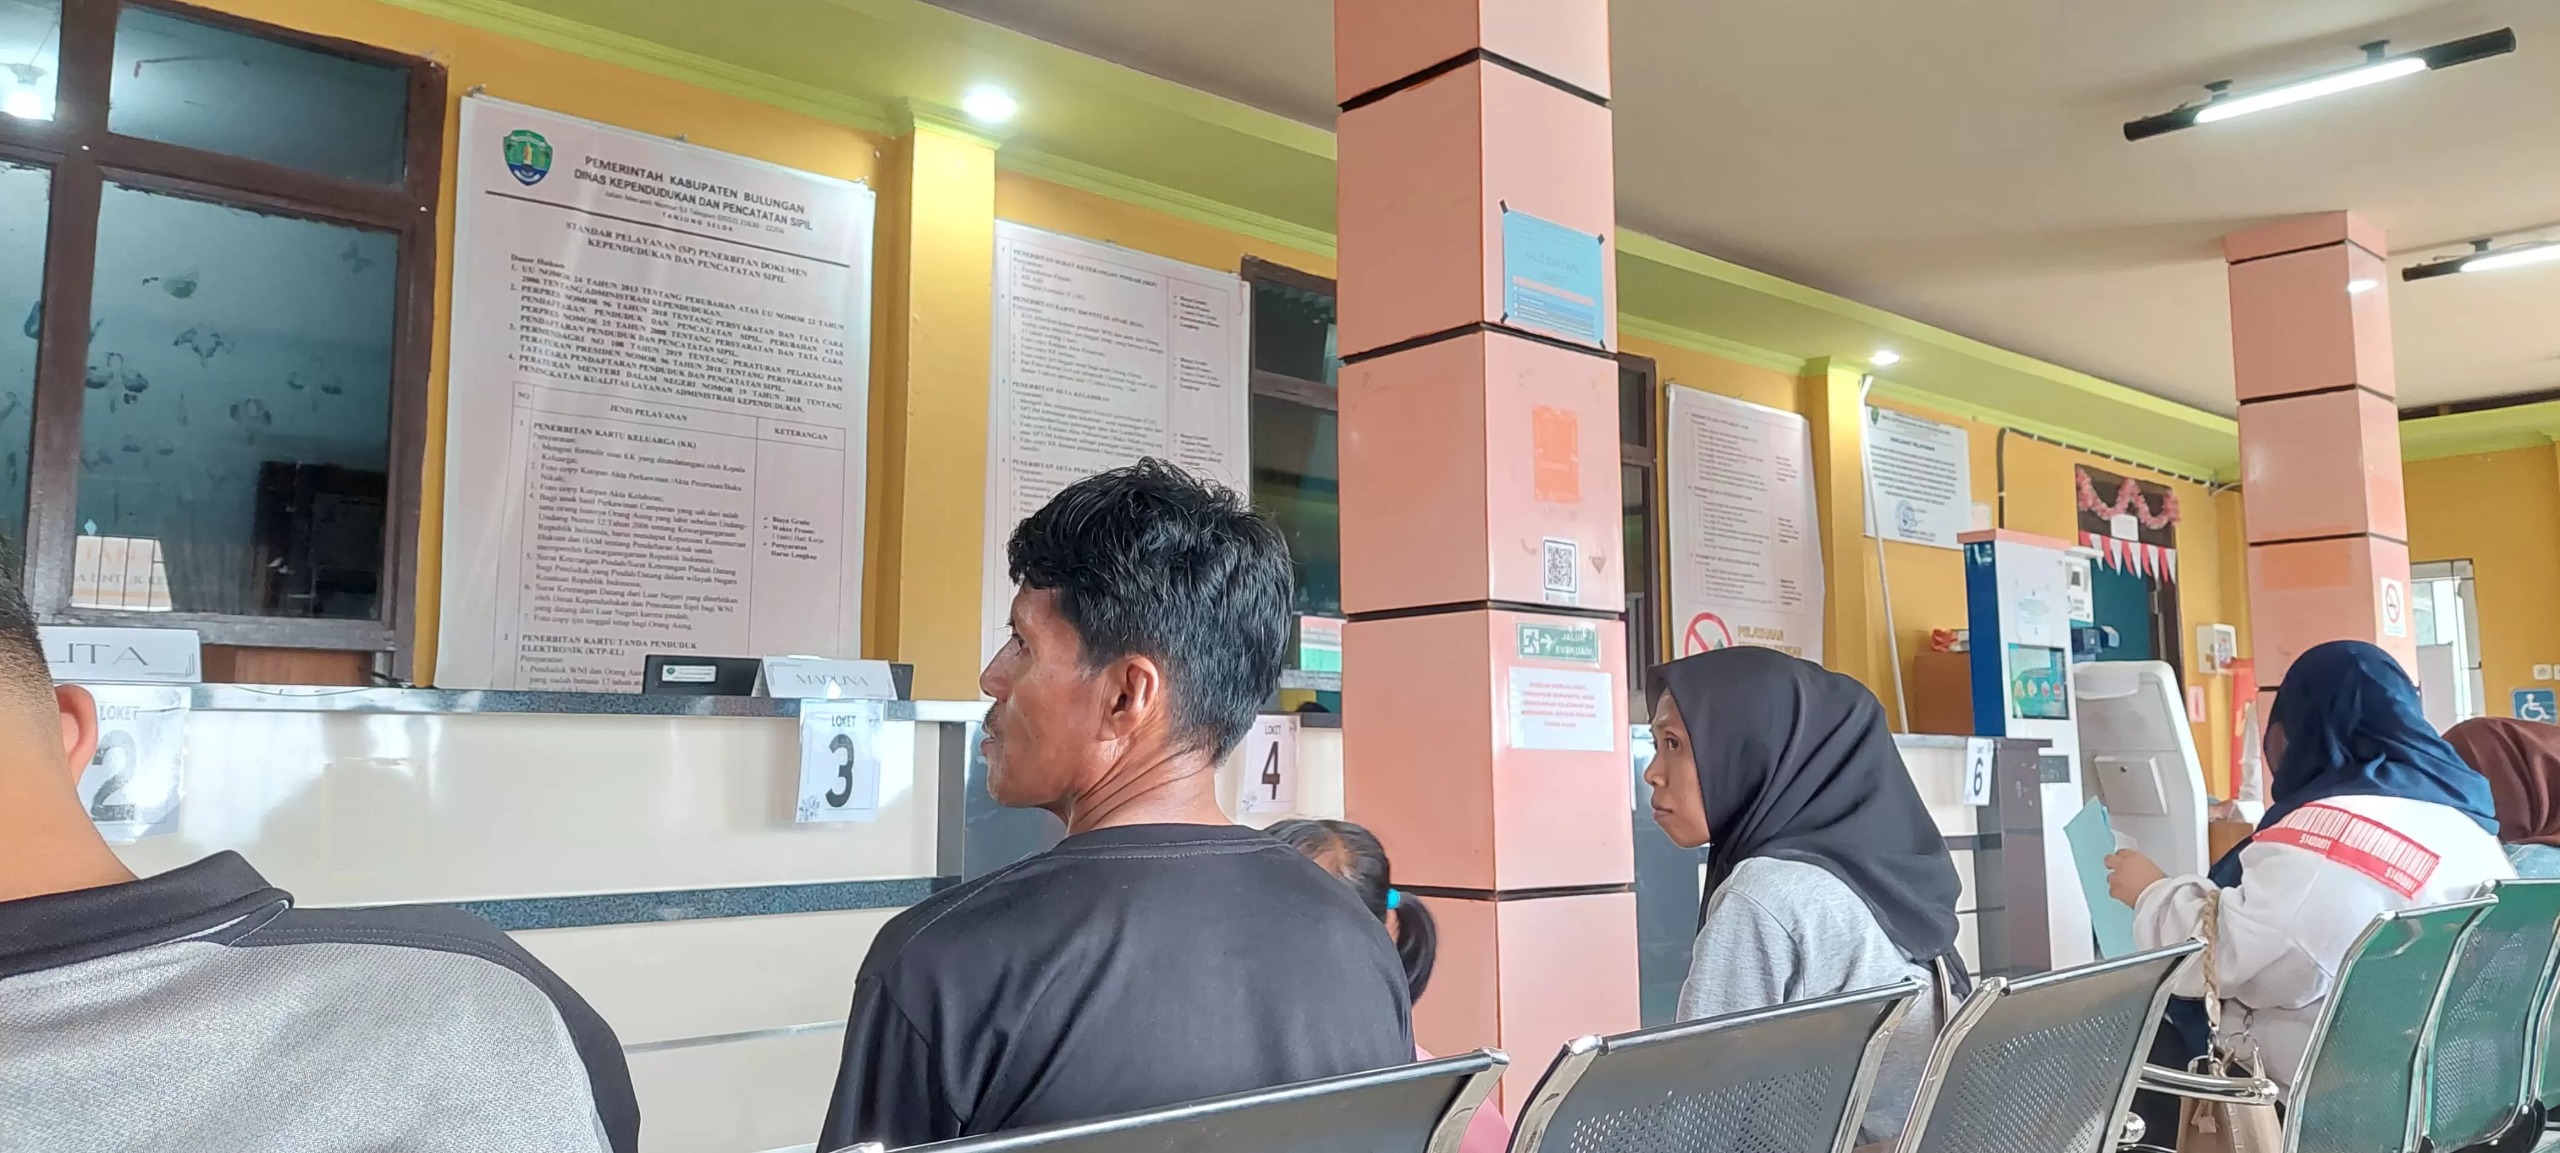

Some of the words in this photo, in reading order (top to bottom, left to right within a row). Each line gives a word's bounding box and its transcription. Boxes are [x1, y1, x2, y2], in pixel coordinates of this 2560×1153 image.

[574, 168, 605, 186] DINAS
[610, 176, 695, 205] KEPENDUDUKAN
[698, 195, 719, 210] DAN
[722, 200, 787, 224] PENCATATAN
[790, 215, 812, 230] SIPIL
[585, 156, 662, 183] PEMERINTAH
[670, 174, 737, 199] KABUPATEN
[744, 191, 804, 214] BULUNGAN
[662, 211, 702, 226] TANJUNG
[706, 221, 733, 232] SELOR
[566, 222, 612, 238] STANDAR
[615, 231, 676, 251] PELAYANAN
[678, 244, 696, 255] (SP)
[698, 248, 758, 267] PENERBITAN
[760, 261, 806, 277] DOKUMEN
[588, 237, 671, 261] KEPENDUDUKAN
[674, 254, 694, 265] DAN
[697, 259, 760, 278] PENCATATAN
[762, 271, 786, 283] SIPIL
[522, 265, 535, 275] UU
[574, 274, 582, 283] 24
[586, 277, 617, 289] TAHUN
[620, 283, 638, 293] 2013
[642, 287, 680, 300] TENTANG
[685, 295, 735, 310] PERUBAHAN
[738, 304, 758, 314] ATAS
[762, 308, 772, 317] UU
[776, 311, 804, 322] NOMOR
[819, 319, 844, 329] TAHUN
[542, 279, 582, 293] TENTANG
[584, 286, 649, 304] ADMINISTRASI
[520, 285, 559, 299] PERPRES
[564, 293, 597, 305] NOMOR
[616, 302, 646, 314] TAHUN
[651, 308, 667, 317] 2018
[671, 311, 711, 325] TENTANG
[716, 319, 774, 335] PERSYARATAN
[778, 330, 794, 339] DAN
[798, 333, 818, 343] TATA
[822, 337, 842, 347] CARA
[520, 295, 584, 313] PENDAFTARAN
[594, 307, 642, 323] PENDUDUK
[651, 317, 668, 327] DAN
[676, 322, 732, 337] PENCATATAN
[770, 337, 816, 352] PERUBAHAN
[824, 347, 843, 356] ATAS
[520, 315, 583, 332] PENDAFTARAN
[586, 325, 636, 340] PENDUDUK
[638, 334, 656, 344] DAN
[658, 337, 714, 353] PENCATATAN
[520, 305, 558, 318] PERPRES
[562, 312, 597, 324] NOMOR
[616, 321, 645, 332] TAHUN
[670, 330, 710, 343] TENTANG
[715, 337, 773, 353] PERSYARATAN
[777, 348, 793, 357] DAN
[798, 351, 818, 361] TATA
[822, 355, 842, 365] CARA
[520, 325, 584, 342] PERMENDAGRI
[590, 336, 604, 345] NO
[631, 343, 658, 354] TAHUN
[688, 352, 726, 364] TENTANG
[733, 359, 780, 373] PERATURAN
[787, 367, 842, 383] PELAKSANAAN
[520, 335, 570, 350] PERATURAN
[575, 343, 620, 357] PRESIDEN
[625, 351, 656, 363] NOMOR
[673, 359, 701, 370] TAHUN
[706, 364, 720, 373] 2018
[726, 367, 763, 379] TENTANG
[767, 373, 823, 389] PERSYARATAN
[826, 383, 842, 391] DAN
[570, 352, 636, 369] PENDAFTARAN
[639, 363, 686, 377] PENDUDUK
[688, 370, 705, 380] DAN
[707, 373, 761, 388] PENCATATAN
[519, 354, 570, 369] PERATURAN
[577, 363, 620, 377] MENTERI
[626, 370, 656, 382] DALAM
[663, 376, 695, 388] NEGERI
[702, 381, 733, 393] NOMOR
[739, 387, 746, 395] 19
[753, 389, 779, 400] TAHUN
[785, 394, 800, 403] 2018
[806, 397, 842, 409] TENTANG
[583, 374, 629, 388] KUALITAS
[631, 381, 670, 393] LAYANAN
[674, 387, 735, 403] ADMINISTRASI
[609, 404, 632, 414] JENIS
[635, 408, 687, 421] PELAYANAN
[774, 427, 827, 440] KETERANGAN
[533, 421, 592, 436] PENERBITAN
[595, 429, 624, 440] KARTU
[627, 433, 675, 446] KELUARGA
[677, 440, 696, 448] (KK)
[521, 644, 582, 654] ELEKTRONIK
[585, 647, 624, 656] (KTP-EL)
[522, 634, 580, 643] PENERBITAN
[583, 636, 614, 645] KARTU
[618, 638, 647, 646] TANDA
[649, 640, 698, 648] PENDUDUK
[100, 705, 140, 721] LOKET
[831, 714, 857, 728] LOKET
[1264, 724, 1282, 735] LOKET
[90, 730, 136, 822] 2
[825, 733, 855, 808] 3
[1261, 740, 1281, 800] 4
[1973, 757, 1984, 796] 6
